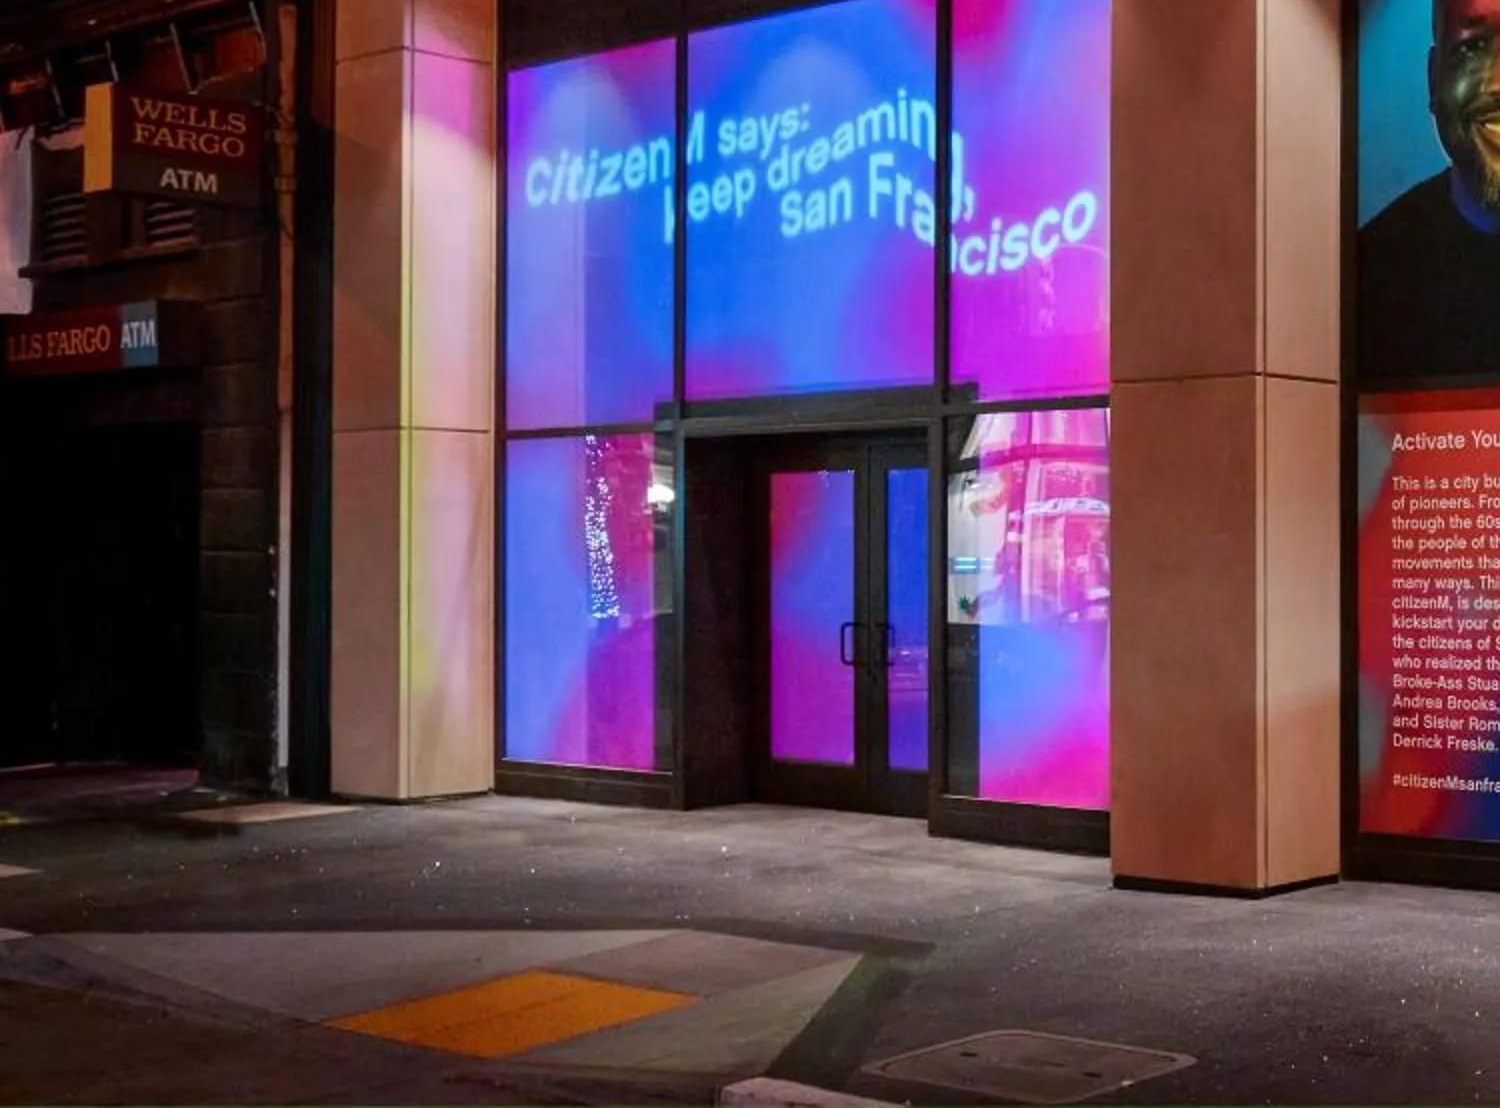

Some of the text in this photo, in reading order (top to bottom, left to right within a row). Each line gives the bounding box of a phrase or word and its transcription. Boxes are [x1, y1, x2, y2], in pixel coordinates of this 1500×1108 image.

[131, 96, 247, 133] WELLS
[132, 123, 245, 157] FARGO
[718, 102, 811, 161] says:
[160, 168, 218, 193] ATM
[780, 152, 1096, 276] San Fracisco
[46, 324, 112, 358] FARGO
[120, 319, 156, 349] ATM
[1392, 433, 1466, 451] Activate
[1392, 476, 1420, 490] This
[1424, 476, 1437, 489] is
[1439, 478, 1449, 489] a
[1453, 476, 1480, 492] city
[1392, 496, 1405, 511] of
[1410, 496, 1474, 513] pioneers.
[1391, 516, 1444, 533] through
[1450, 515, 1472, 529] the
[1392, 536, 1413, 550] the
[1419, 535, 1467, 553] people
[1471, 534, 1485, 549] of
[1392, 556, 1474, 569] movements
[1392, 578, 1430, 593] many
[1434, 578, 1474, 593] ways.
[1392, 596, 1452, 611] citizenM,
[1458, 596, 1470, 610] is
[1392, 616, 1453, 629] kickstart
[1457, 619, 1488, 633] your
[1392, 636, 1414, 648] the
[1419, 636, 1472, 650] citizens
[1477, 636, 1491, 650] of
[1392, 656, 1422, 668] who
[1426, 657, 1482, 670] realized
[1392, 674, 1463, 690] Broke-Ass
[1393, 695, 1442, 709] Andrea
[1447, 696, 1500, 713] Brooks,
[1393, 715, 1419, 728] and
[1424, 715, 1464, 730] Sister
[1393, 734, 1442, 748] Derrick
